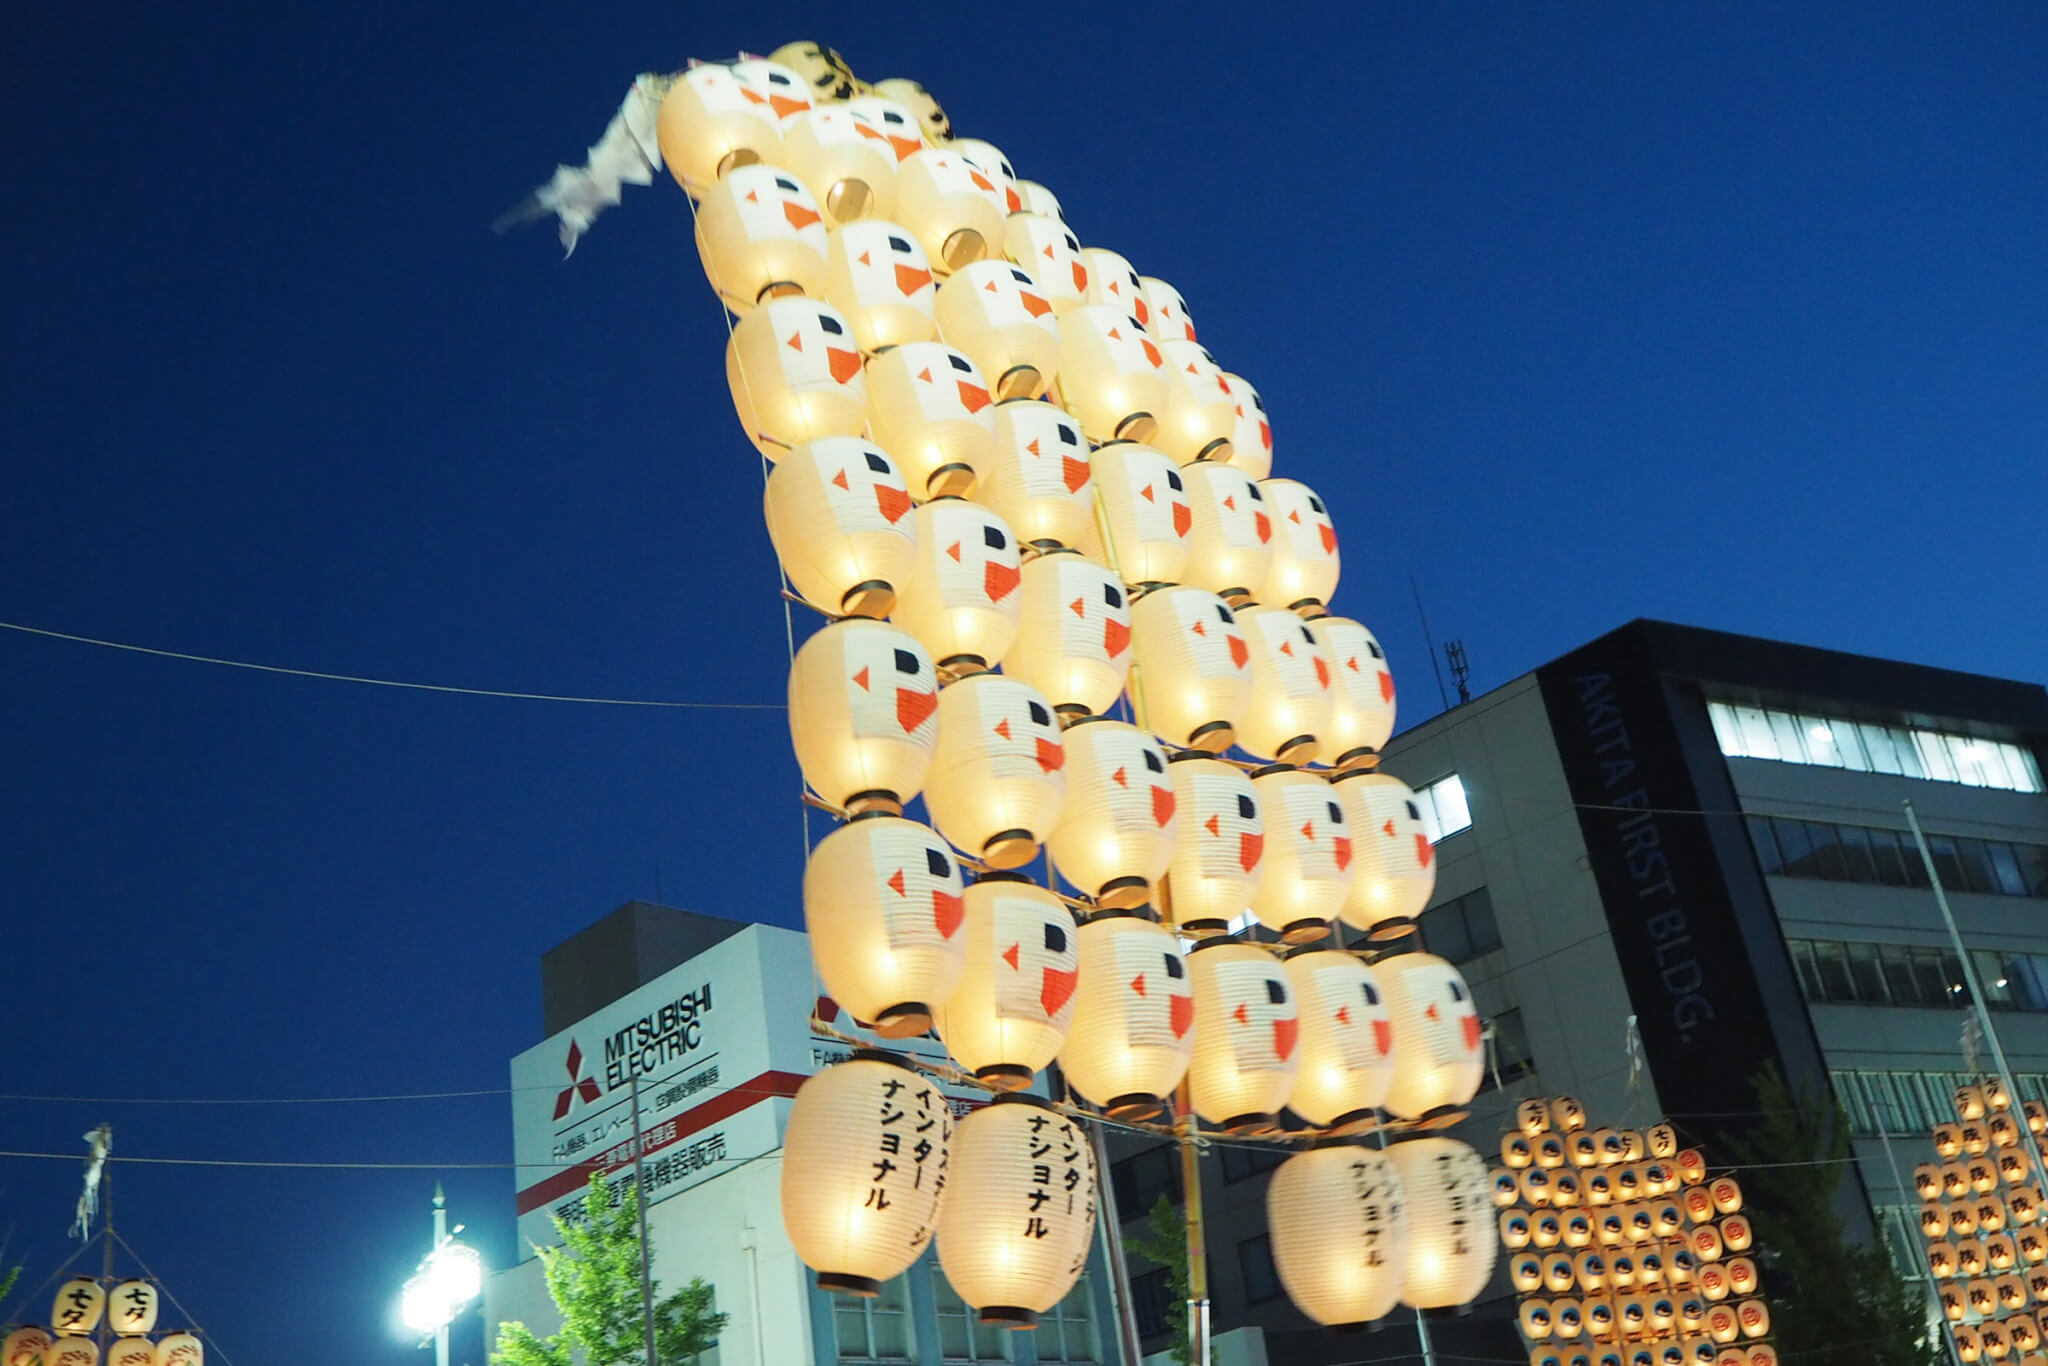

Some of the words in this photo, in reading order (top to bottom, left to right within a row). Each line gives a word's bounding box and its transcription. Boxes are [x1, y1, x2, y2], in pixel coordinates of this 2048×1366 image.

[1574, 671, 1636, 787] AKITA
[1611, 788, 1678, 898] FIRST
[604, 981, 712, 1065] MITSUBISHI
[606, 1020, 702, 1092] ELECTRIC
[914, 1088, 936, 1190] インター
[1060, 1123, 1080, 1216] インター
[60, 1288, 95, 1328] 七夕
[123, 1287, 151, 1326] 七夕
